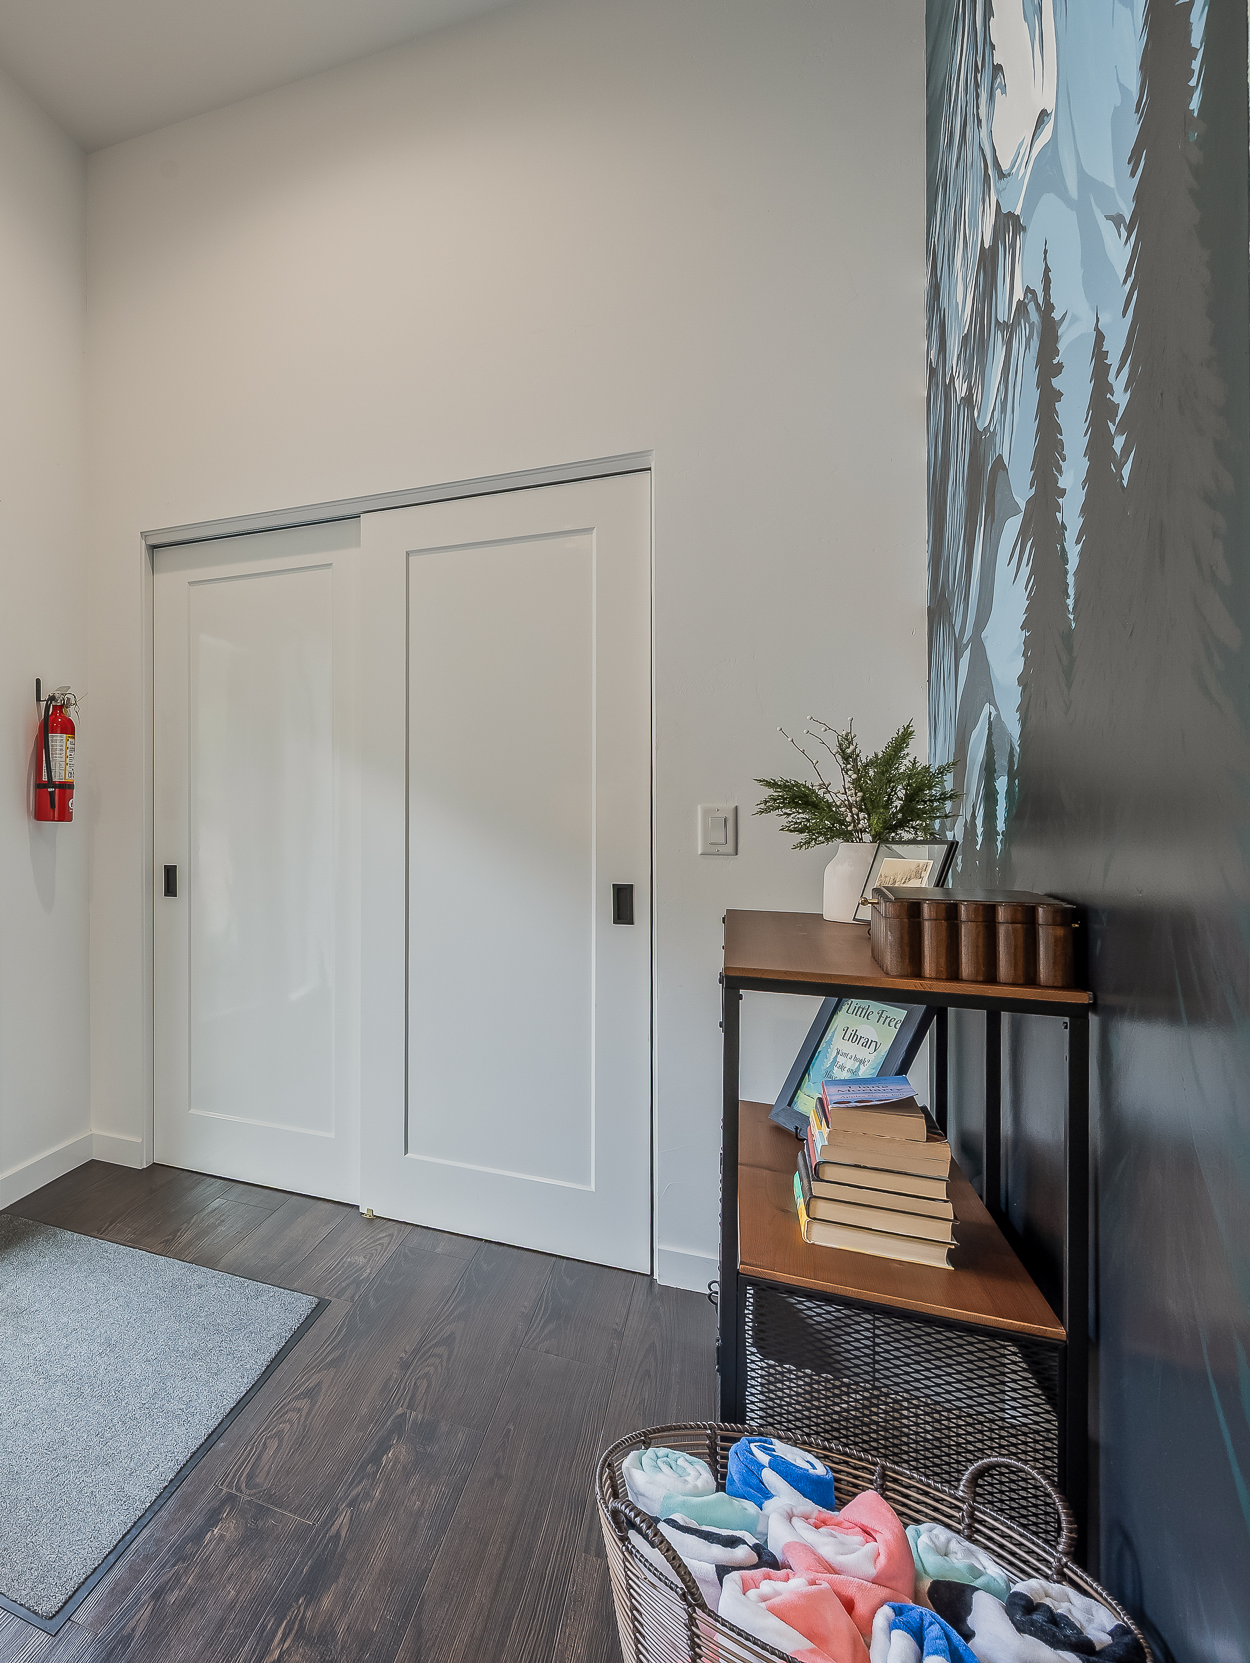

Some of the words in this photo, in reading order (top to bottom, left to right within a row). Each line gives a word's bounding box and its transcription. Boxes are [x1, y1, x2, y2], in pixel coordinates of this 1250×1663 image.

[845, 1000, 874, 1021] Little
[876, 1010, 902, 1029] Free
[841, 1026, 882, 1055] Library
[834, 1061, 847, 1072] Take
[836, 1048, 849, 1058] Want
[853, 1055, 870, 1067] book?
